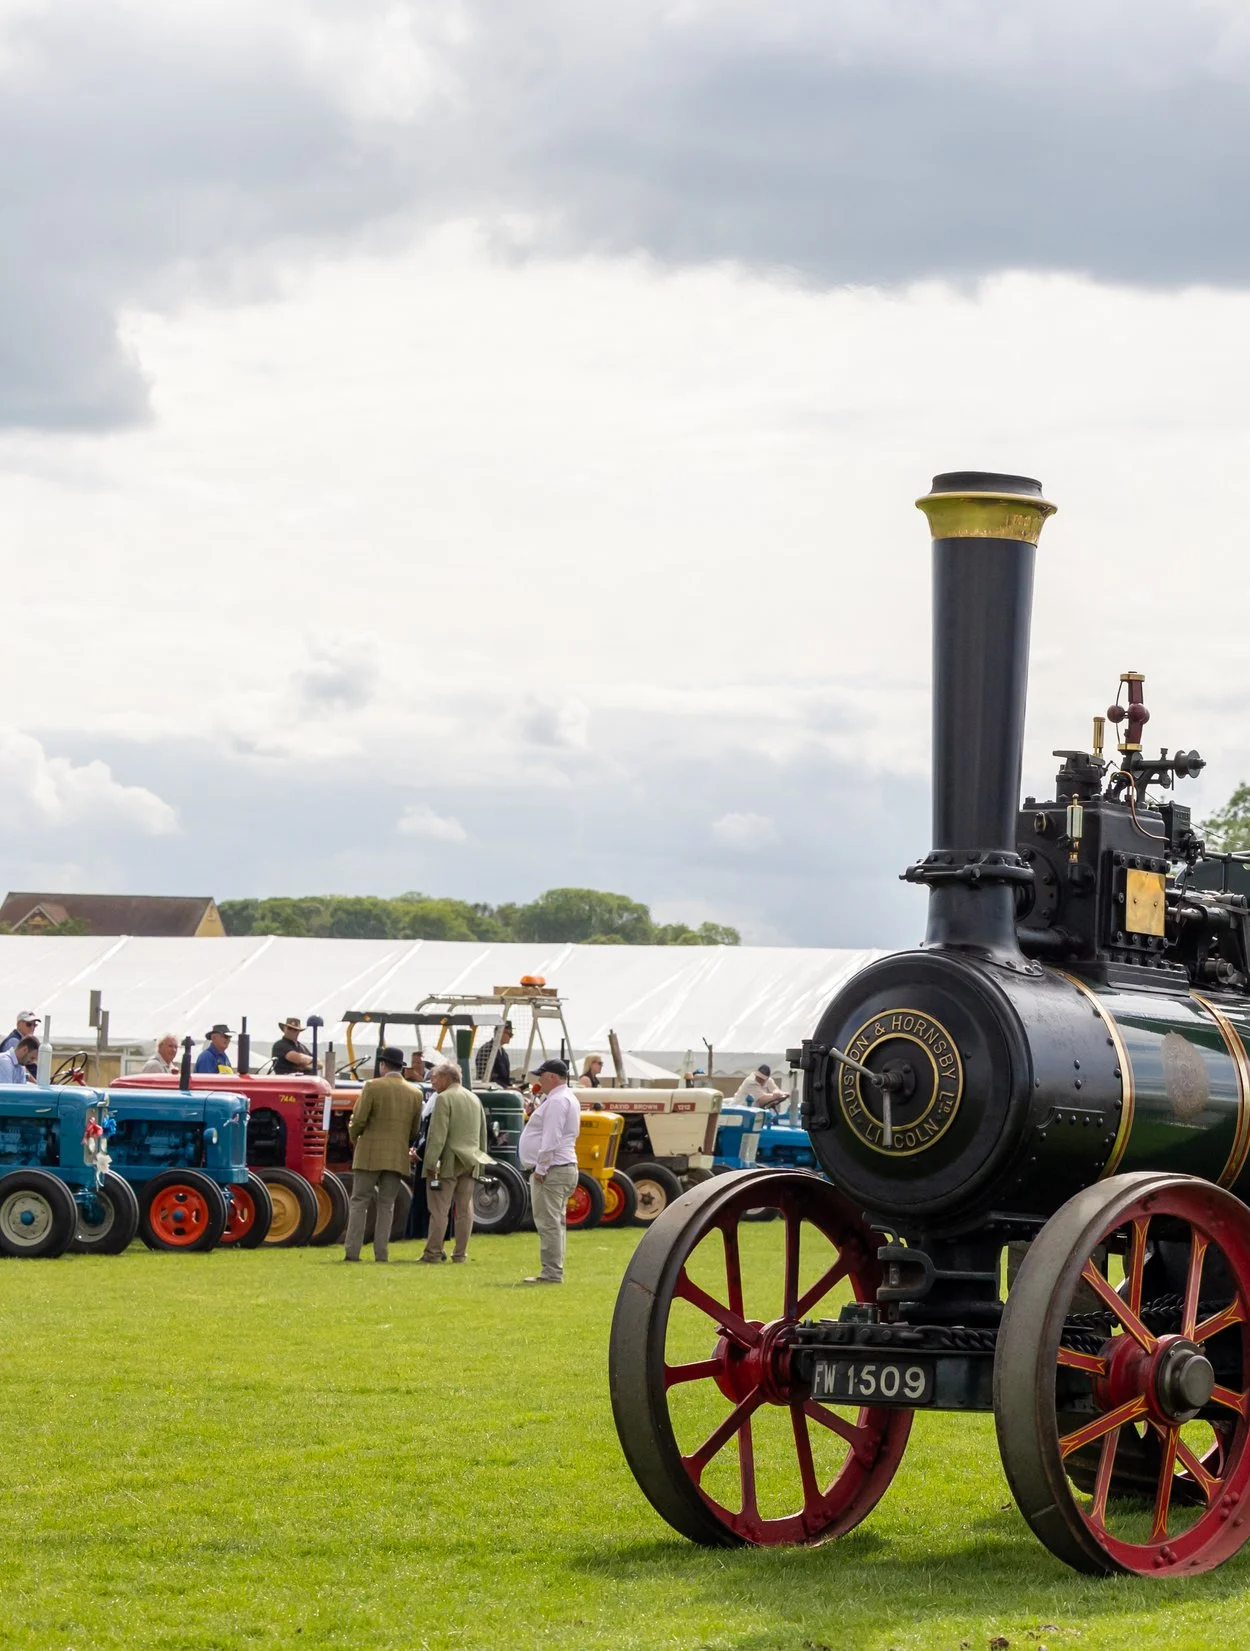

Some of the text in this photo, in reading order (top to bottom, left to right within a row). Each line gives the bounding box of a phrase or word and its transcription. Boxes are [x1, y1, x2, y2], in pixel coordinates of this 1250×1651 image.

[874, 1022, 886, 1036] &
[891, 1016, 957, 1080] HORNSBY
[633, 1103, 658, 1111] BROWN
[865, 1118, 939, 1148] LICOLN
[814, 1364, 926, 1398] FW 1509
